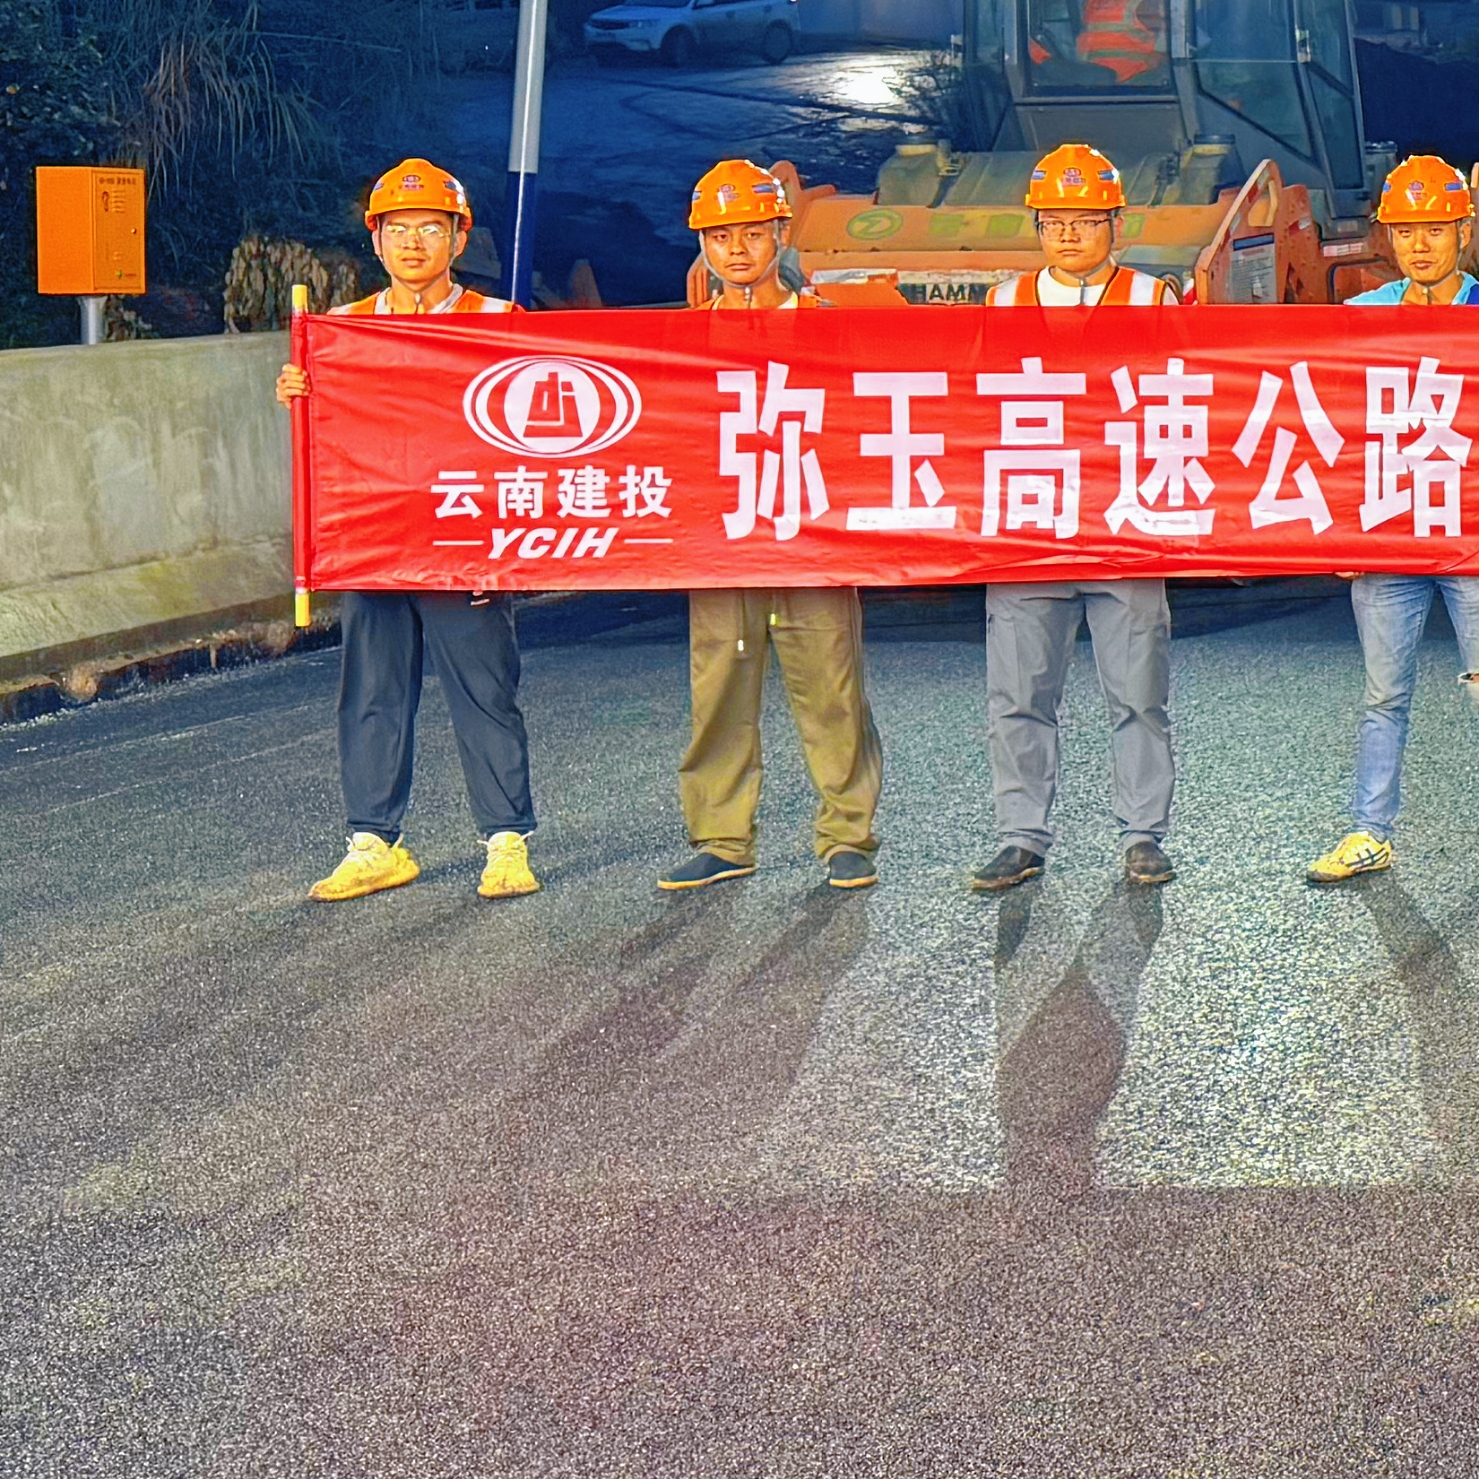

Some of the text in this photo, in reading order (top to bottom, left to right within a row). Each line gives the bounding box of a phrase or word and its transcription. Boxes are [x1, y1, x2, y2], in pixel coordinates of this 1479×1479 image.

[430, 465, 673, 519] 云南建投
[487, 527, 619, 560] YCIH
